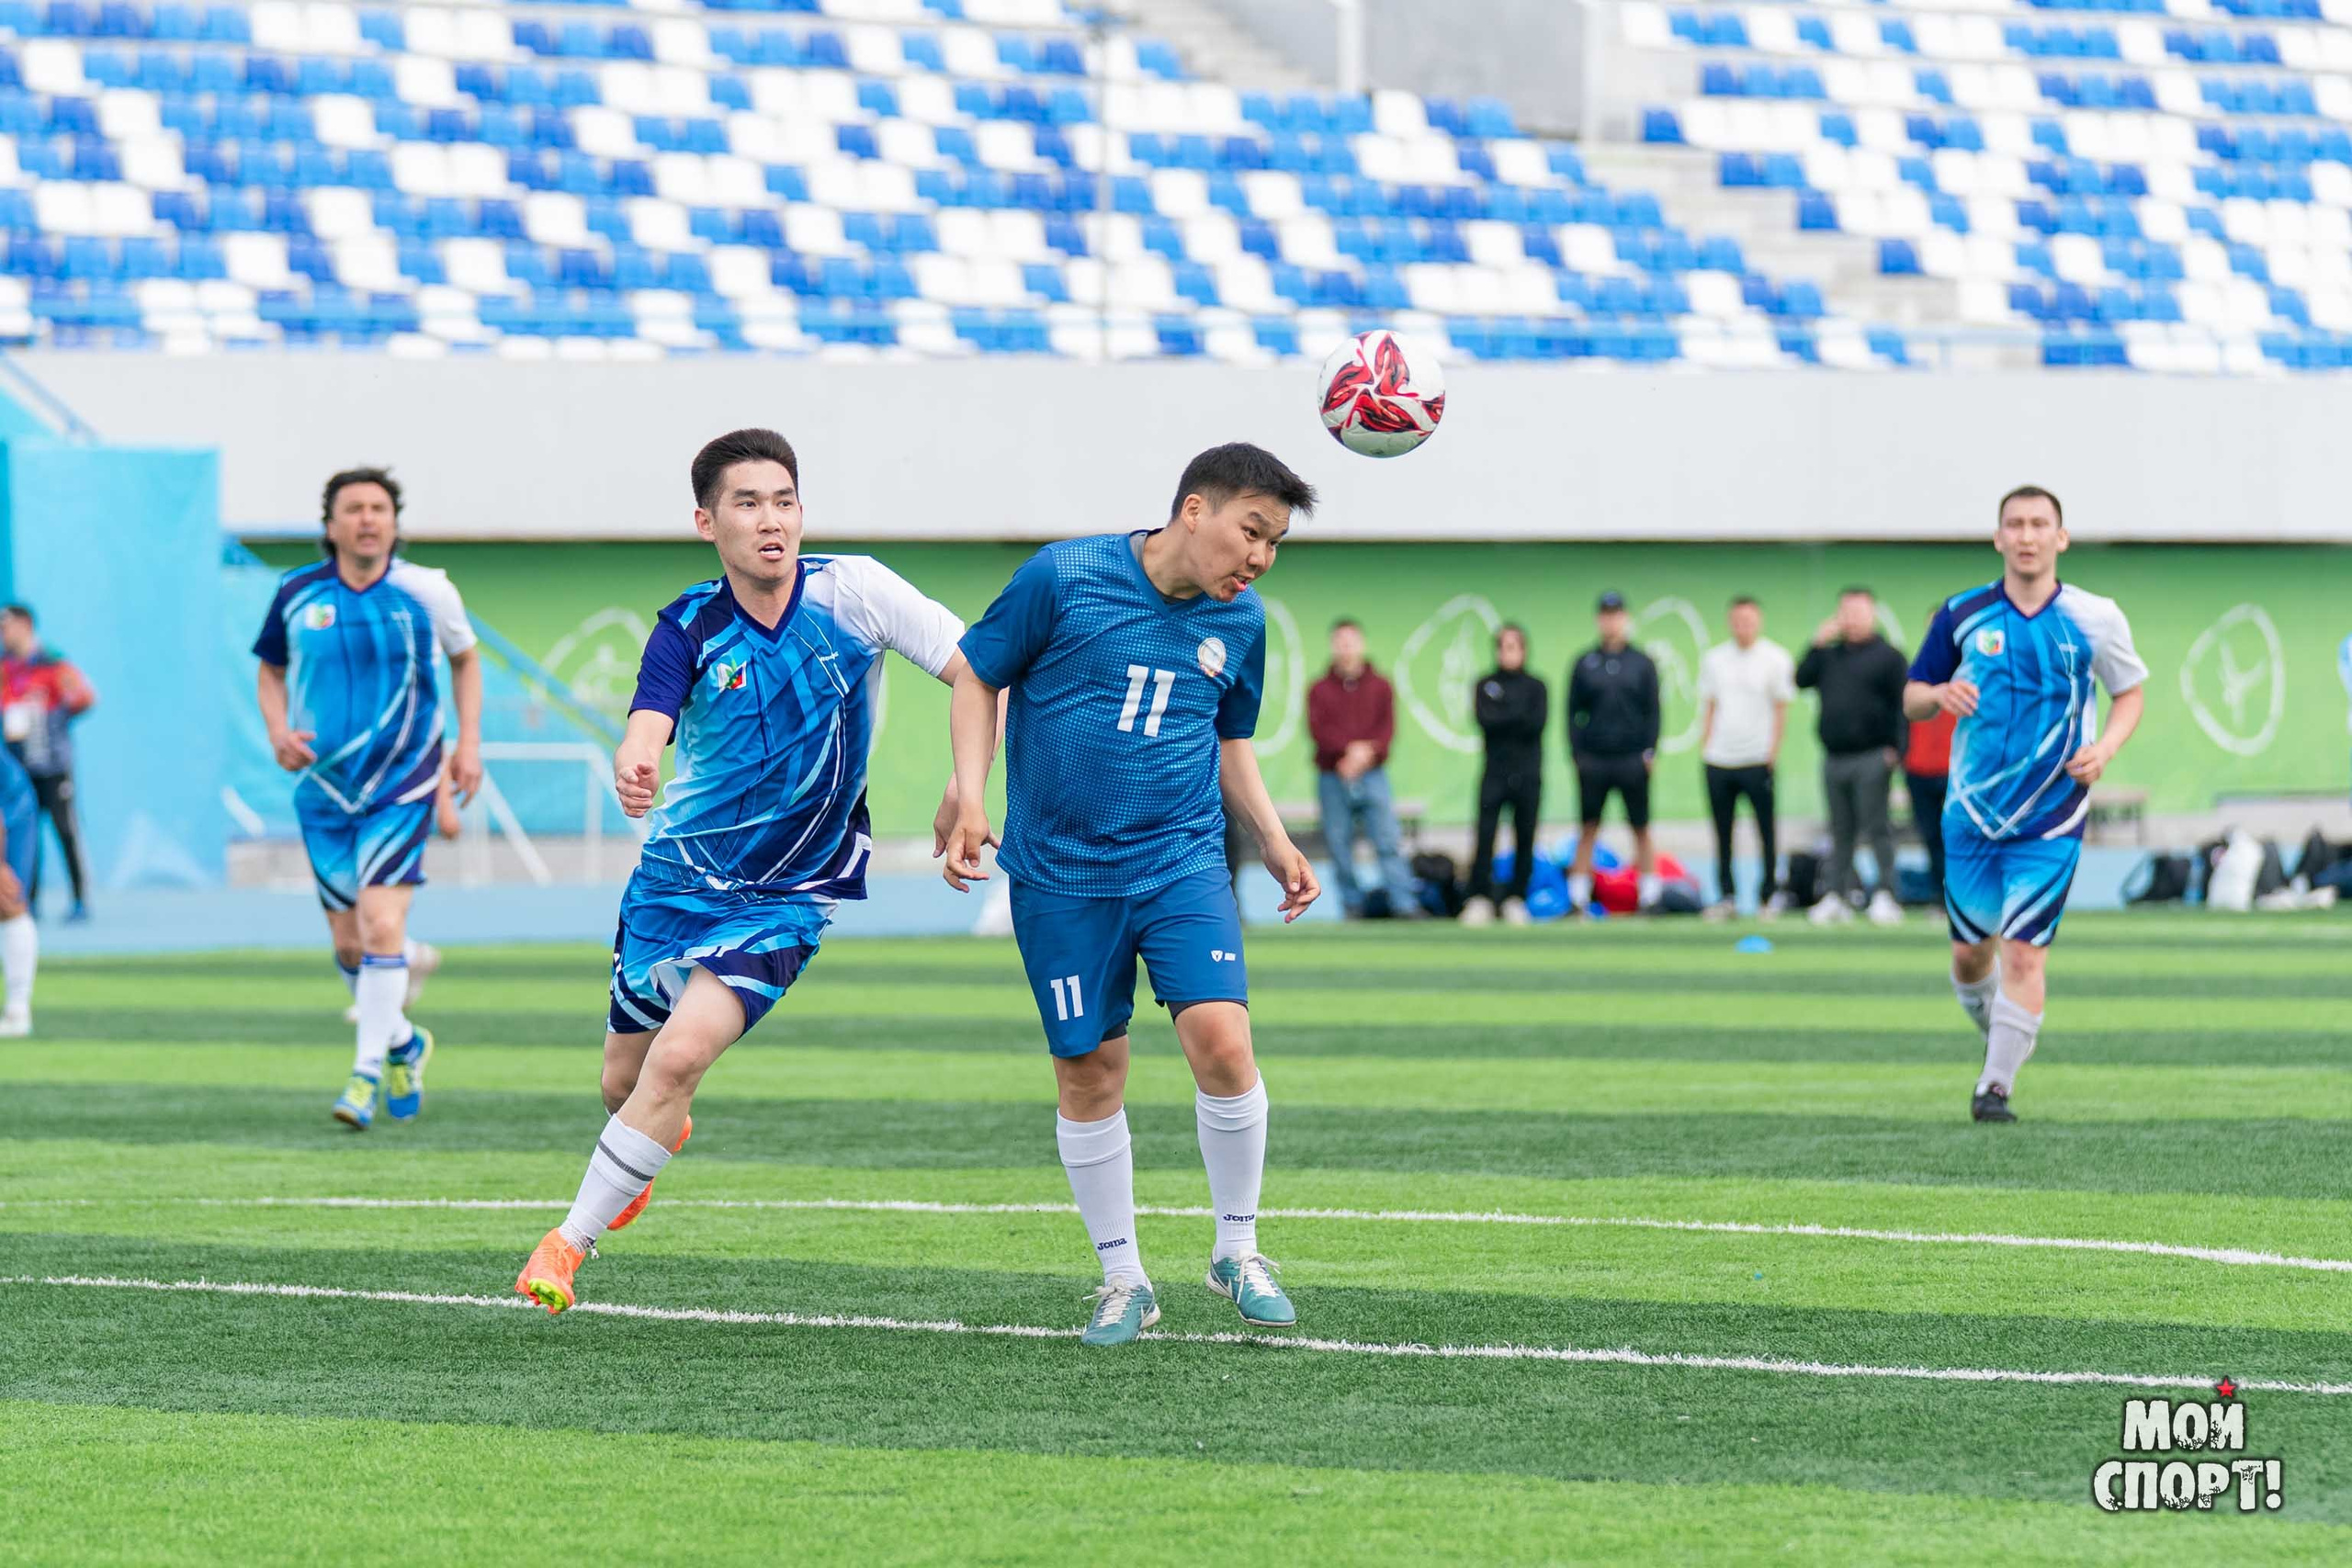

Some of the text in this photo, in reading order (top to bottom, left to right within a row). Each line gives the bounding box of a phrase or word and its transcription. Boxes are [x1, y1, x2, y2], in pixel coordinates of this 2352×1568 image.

[1116, 663, 1176, 738] 11
[1050, 975, 1084, 1021] 11
[1097, 1237, 1127, 1250] Joma
